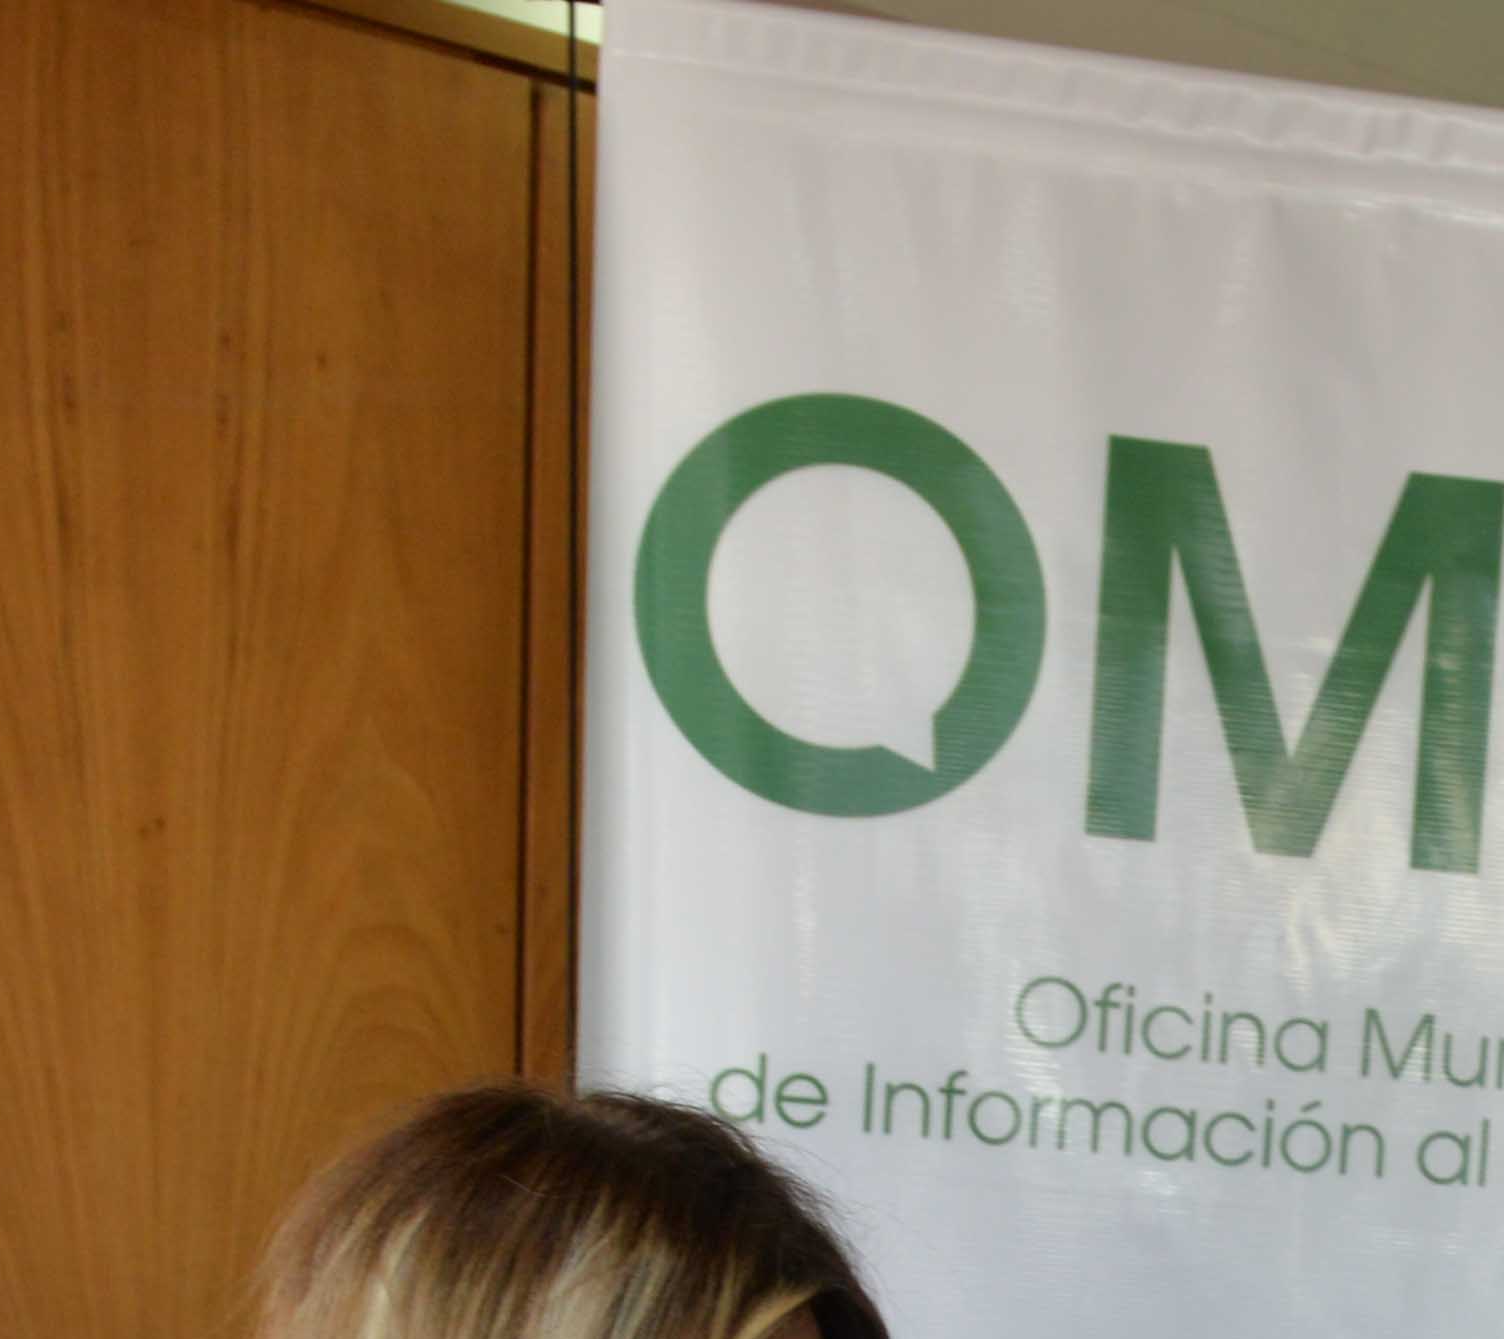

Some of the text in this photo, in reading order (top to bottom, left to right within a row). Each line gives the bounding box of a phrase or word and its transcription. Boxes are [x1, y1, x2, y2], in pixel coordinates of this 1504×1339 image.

[1013, 973, 1330, 1081] Oficina
[709, 1054, 828, 1134] de
[860, 1061, 1388, 1185] Información
[1415, 1118, 1492, 1193] al
